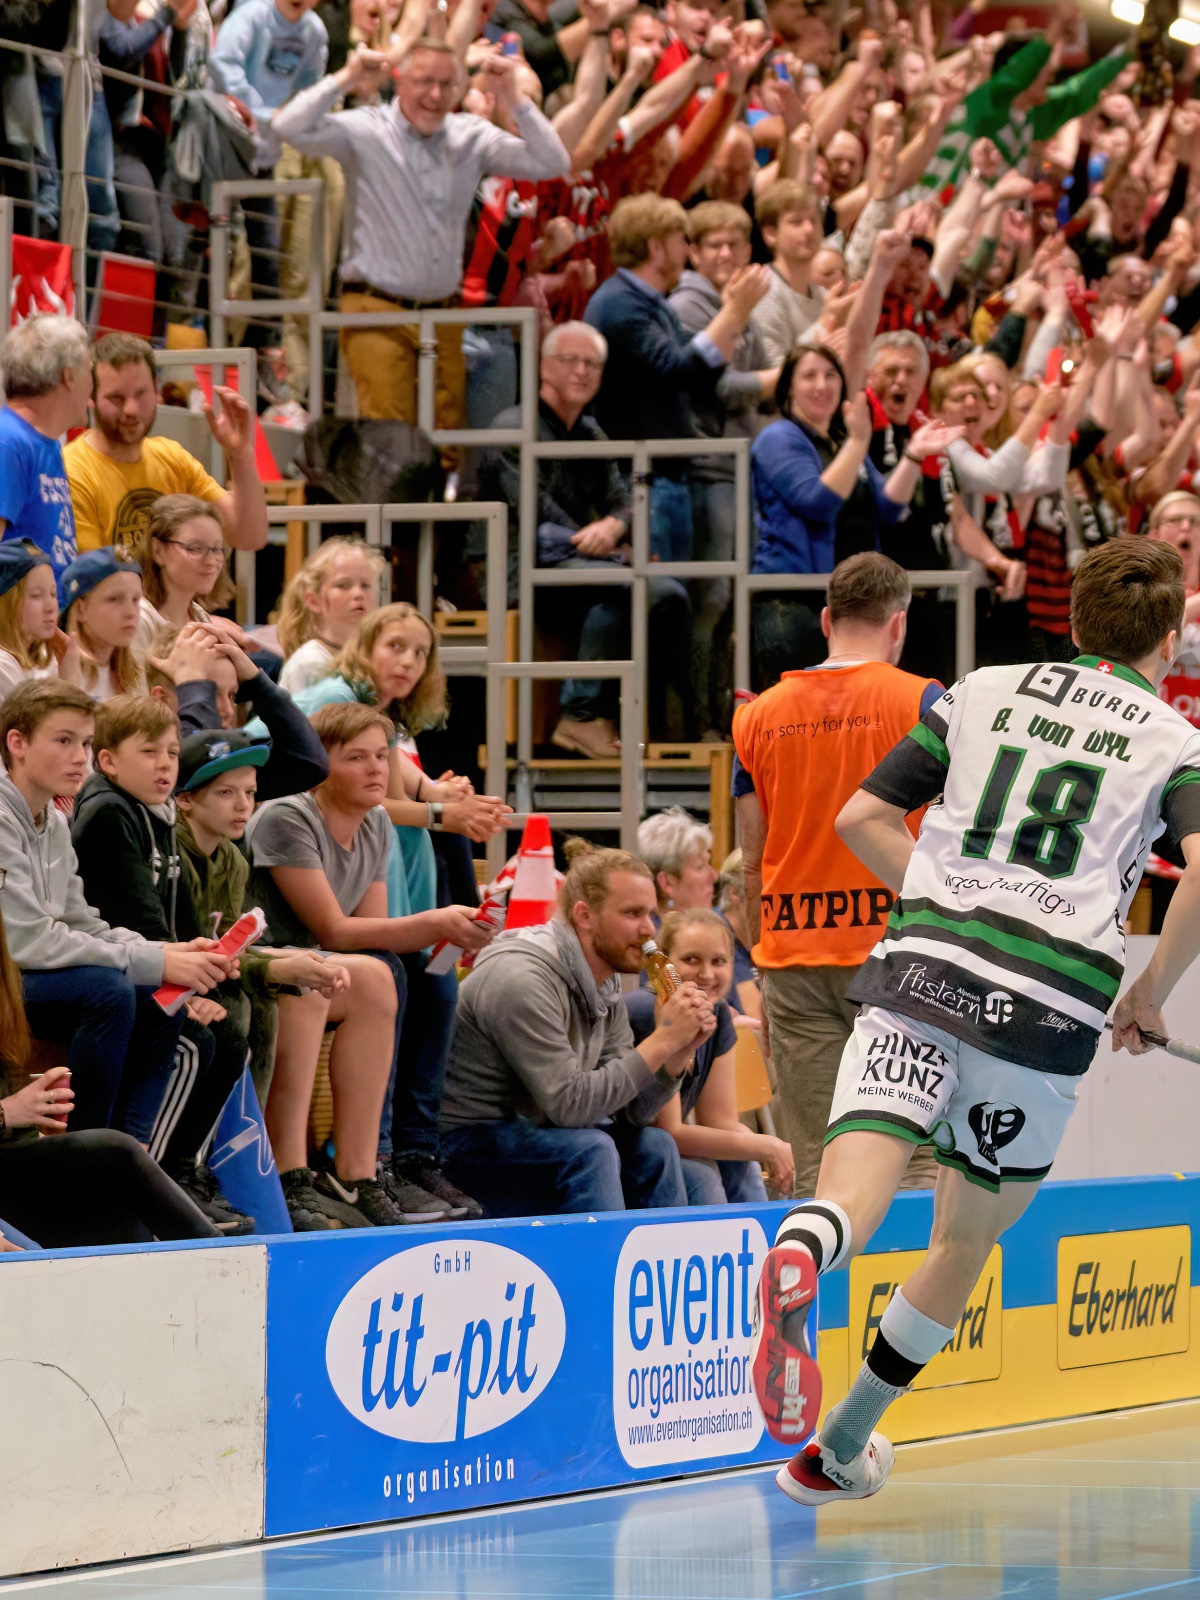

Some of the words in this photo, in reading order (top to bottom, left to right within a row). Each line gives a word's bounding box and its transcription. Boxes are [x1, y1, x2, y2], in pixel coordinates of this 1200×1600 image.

[822, 715, 844, 732] for
[847, 715, 871, 731] you
[1071, 687, 1152, 724] BÜRGI
[961, 744, 1107, 880] 18
[861, 1057, 945, 1099] KUNZ
[857, 1086, 895, 1098] MEINE
[898, 1090, 935, 1115] WERBER
[434, 1251, 471, 1274] GmbH
[629, 1229, 754, 1351] event
[1068, 1256, 1184, 1337] Eberhard
[361, 1282, 538, 1442] tit-pit
[628, 1405, 753, 1446] www.eventorganisation.ch
[384, 1453, 515, 1503] organisation
